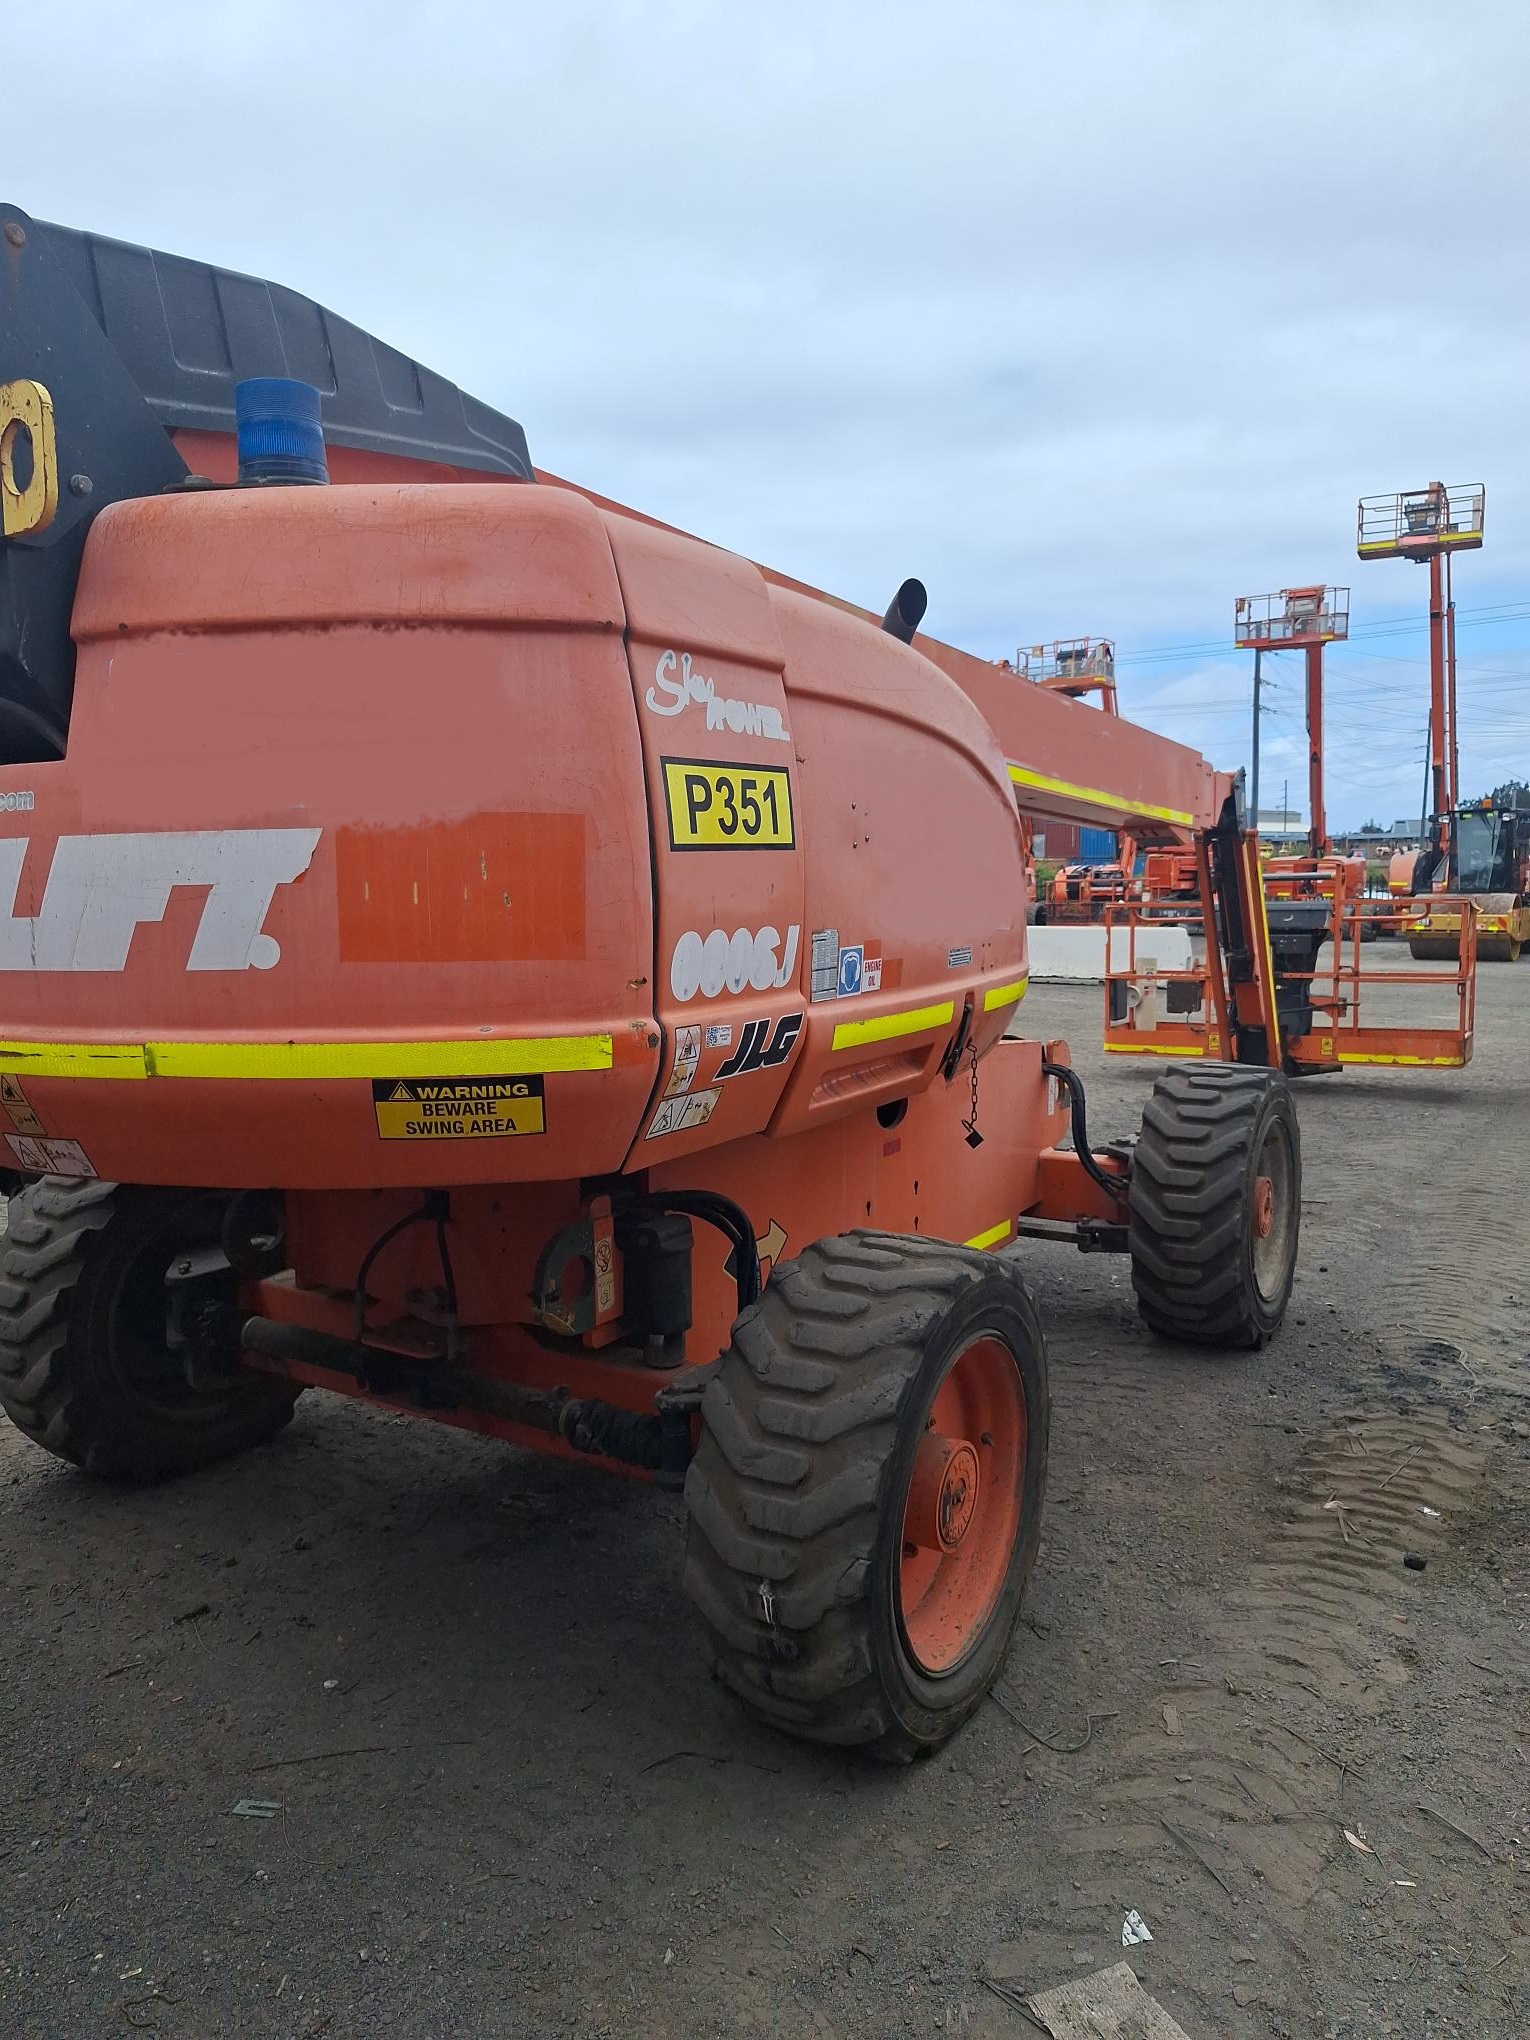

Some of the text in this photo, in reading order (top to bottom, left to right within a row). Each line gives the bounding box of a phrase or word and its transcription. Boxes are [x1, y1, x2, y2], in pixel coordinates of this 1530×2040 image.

[684, 773, 779, 836] P351
[864, 960, 882, 973] ENGINE
[712, 1012, 804, 1082] JLG
[416, 1083, 529, 1099] WARNING
[422, 1101, 497, 1117] BEWARE
[406, 1118, 517, 1135] SWING AREA
